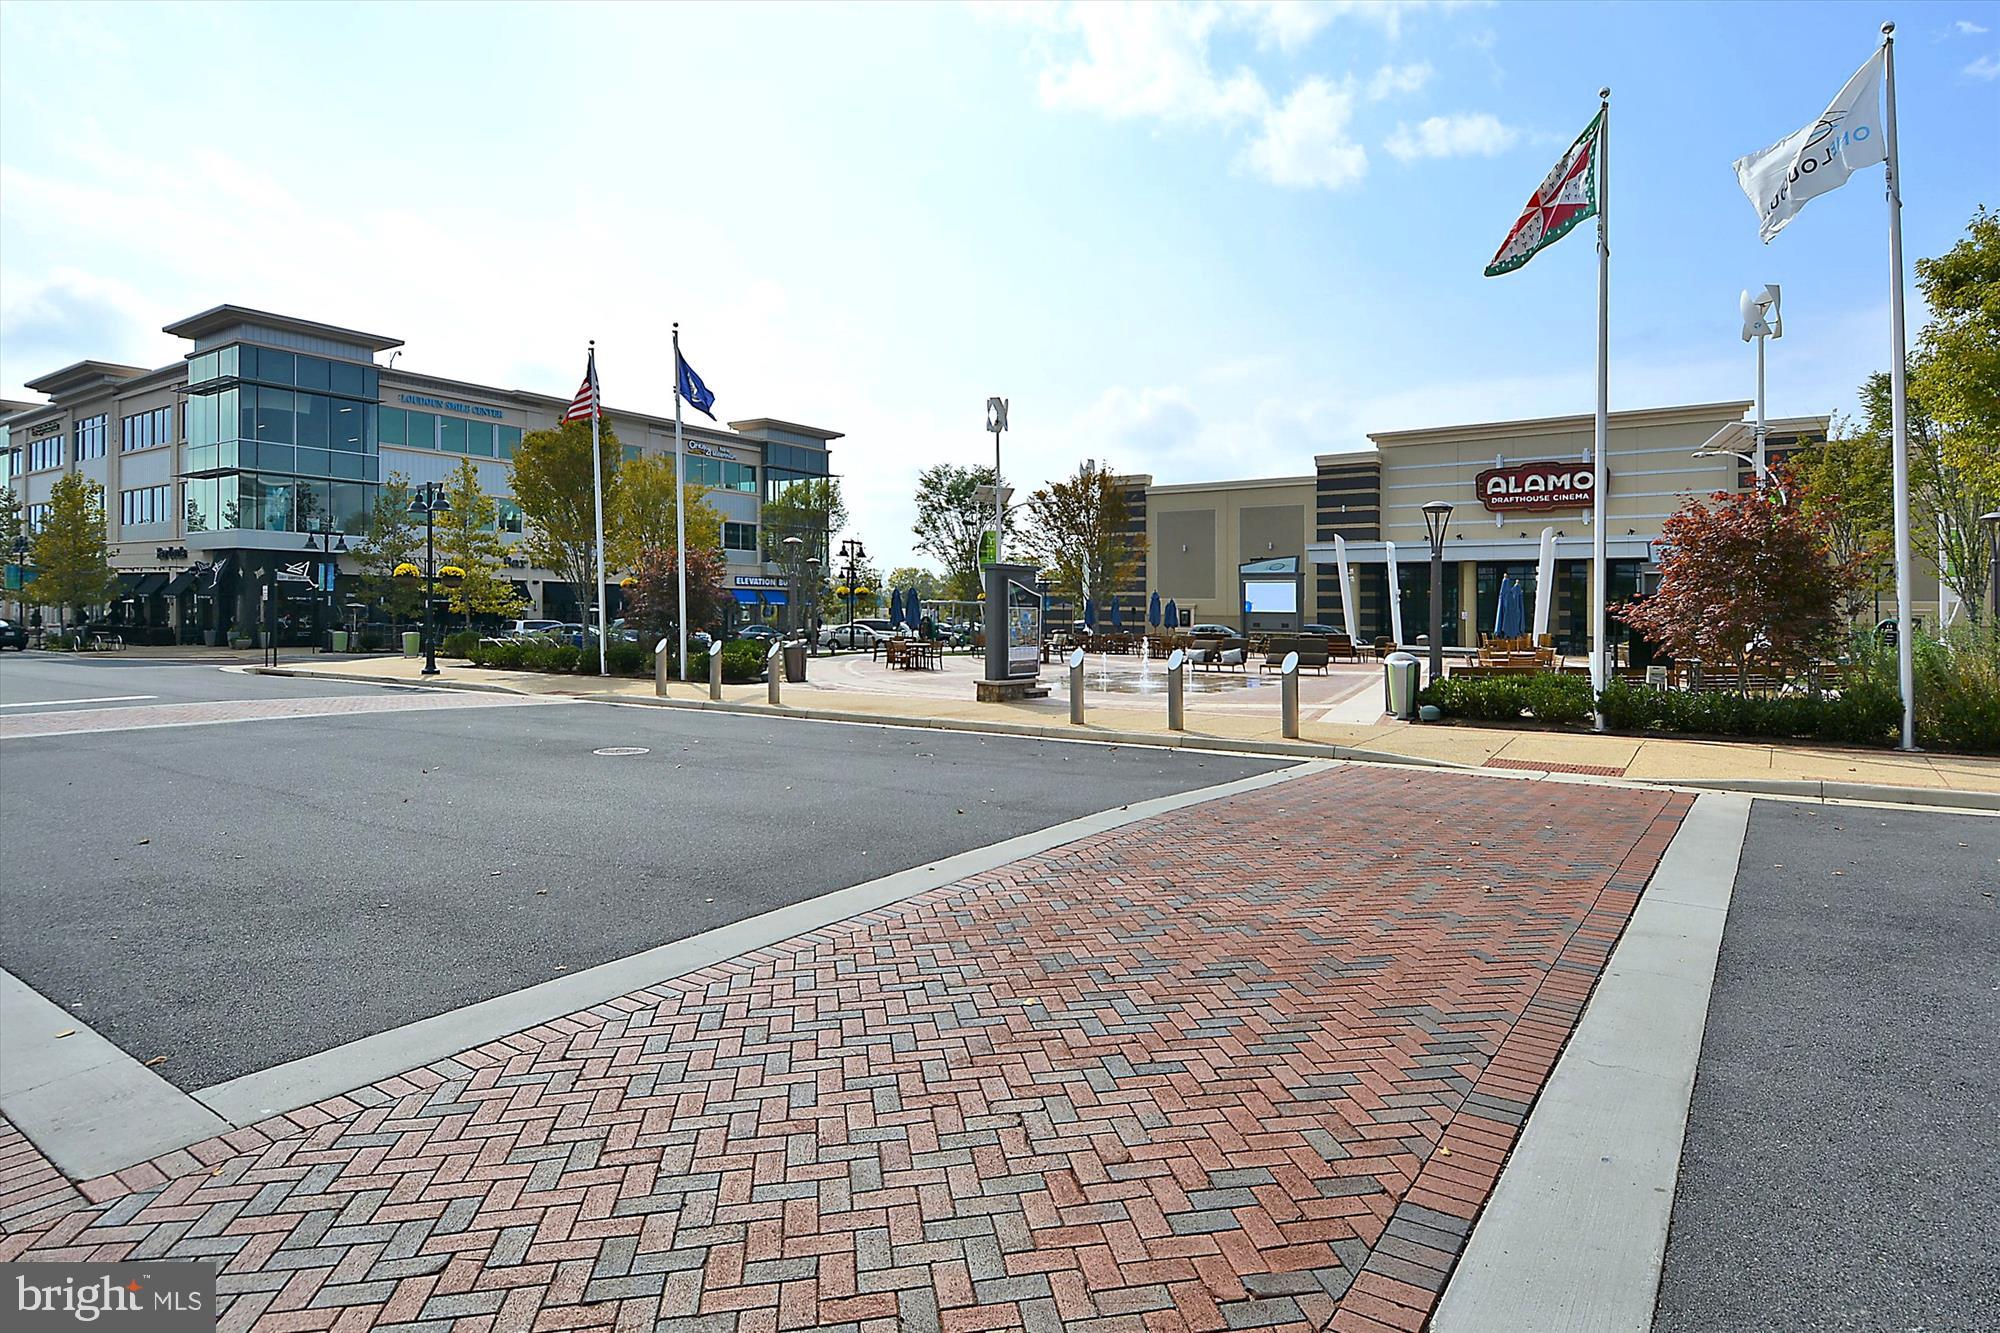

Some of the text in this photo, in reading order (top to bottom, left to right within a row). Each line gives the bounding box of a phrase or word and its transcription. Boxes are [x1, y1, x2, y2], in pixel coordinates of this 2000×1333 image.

[401, 393, 444, 408] LOUDOUN
[472, 406, 503, 418] CENTER
[1487, 471, 1594, 495] ALAMO
[1491, 493, 1590, 504] DRAFTHOUSE CINEMA
[736, 577, 776, 586] ELEVATION
